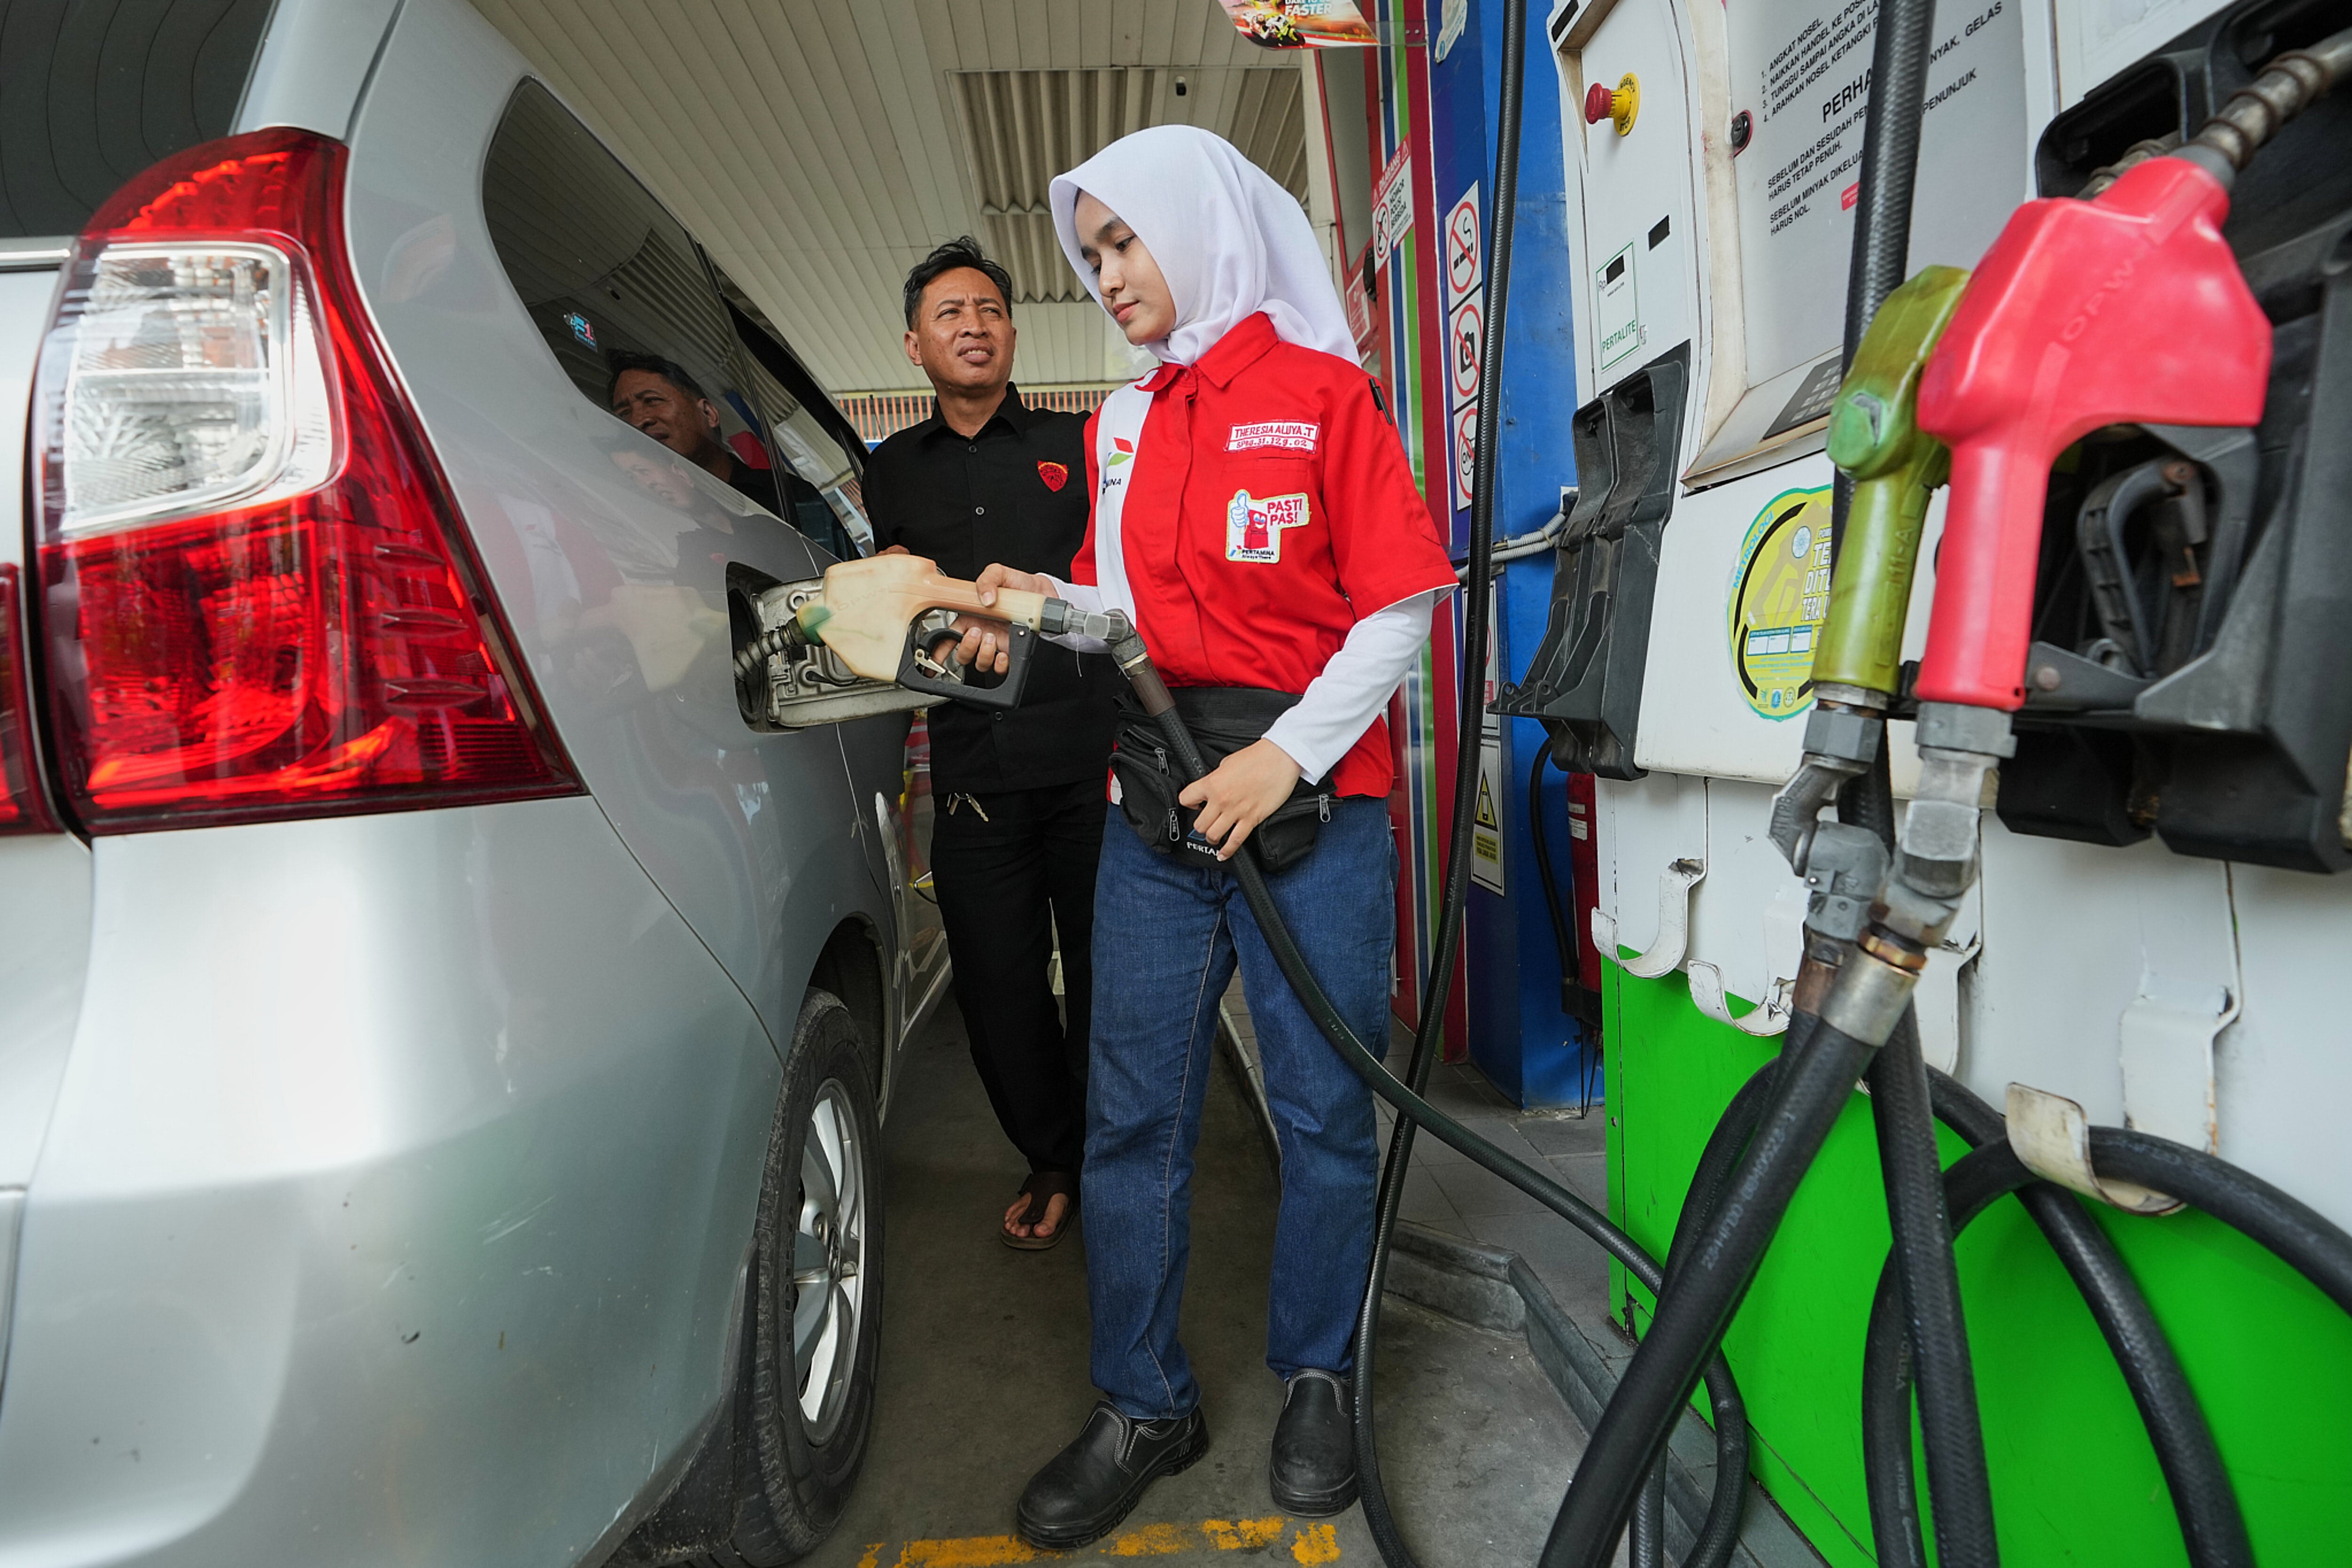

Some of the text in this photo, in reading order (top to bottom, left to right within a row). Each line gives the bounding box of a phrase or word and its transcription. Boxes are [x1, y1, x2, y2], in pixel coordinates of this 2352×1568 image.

[1285, 3, 1332, 16] FASTER
[1769, 40, 1796, 72] ANGKAT
[1797, 18, 1823, 45] NOSEL
[1770, 54, 1800, 87] NAIKKAN
[1801, 26, 1830, 58] HANDEL
[1831, 13, 1842, 30] KE
[1771, 70, 1799, 101] TUNGGU
[1800, 45, 1827, 75] SAMPAI
[1828, 20, 1856, 50] ANGKA
[1857, 10, 1866, 24] DI
[1772, 81, 1804, 117] ARAHKAN
[1806, 61, 1830, 87] NOSEL
[1831, 25, 1871, 64] KETANGKI
[1768, 158, 1799, 189] SEBELUM
[1800, 146, 1815, 164] DAN
[1816, 117, 1852, 151] SESUDAH
[1965, 2, 2002, 37] GELAS
[1769, 141, 1843, 201] HARUS TETAP PENUH.
[1770, 196, 1801, 223] SEBELUM
[1802, 174, 1829, 201] MINYAK
[1922, 68, 1977, 115] PENUNJUK
[1770, 214, 1793, 236] HARUS
[1601, 319, 1636, 353] PERTALITE
[1267, 498, 1303, 514] PASTI
[1270, 512, 1297, 526] PAS!
[1733, 510, 1773, 588] METROLOGI
[1801, 595, 1822, 621] TERA
